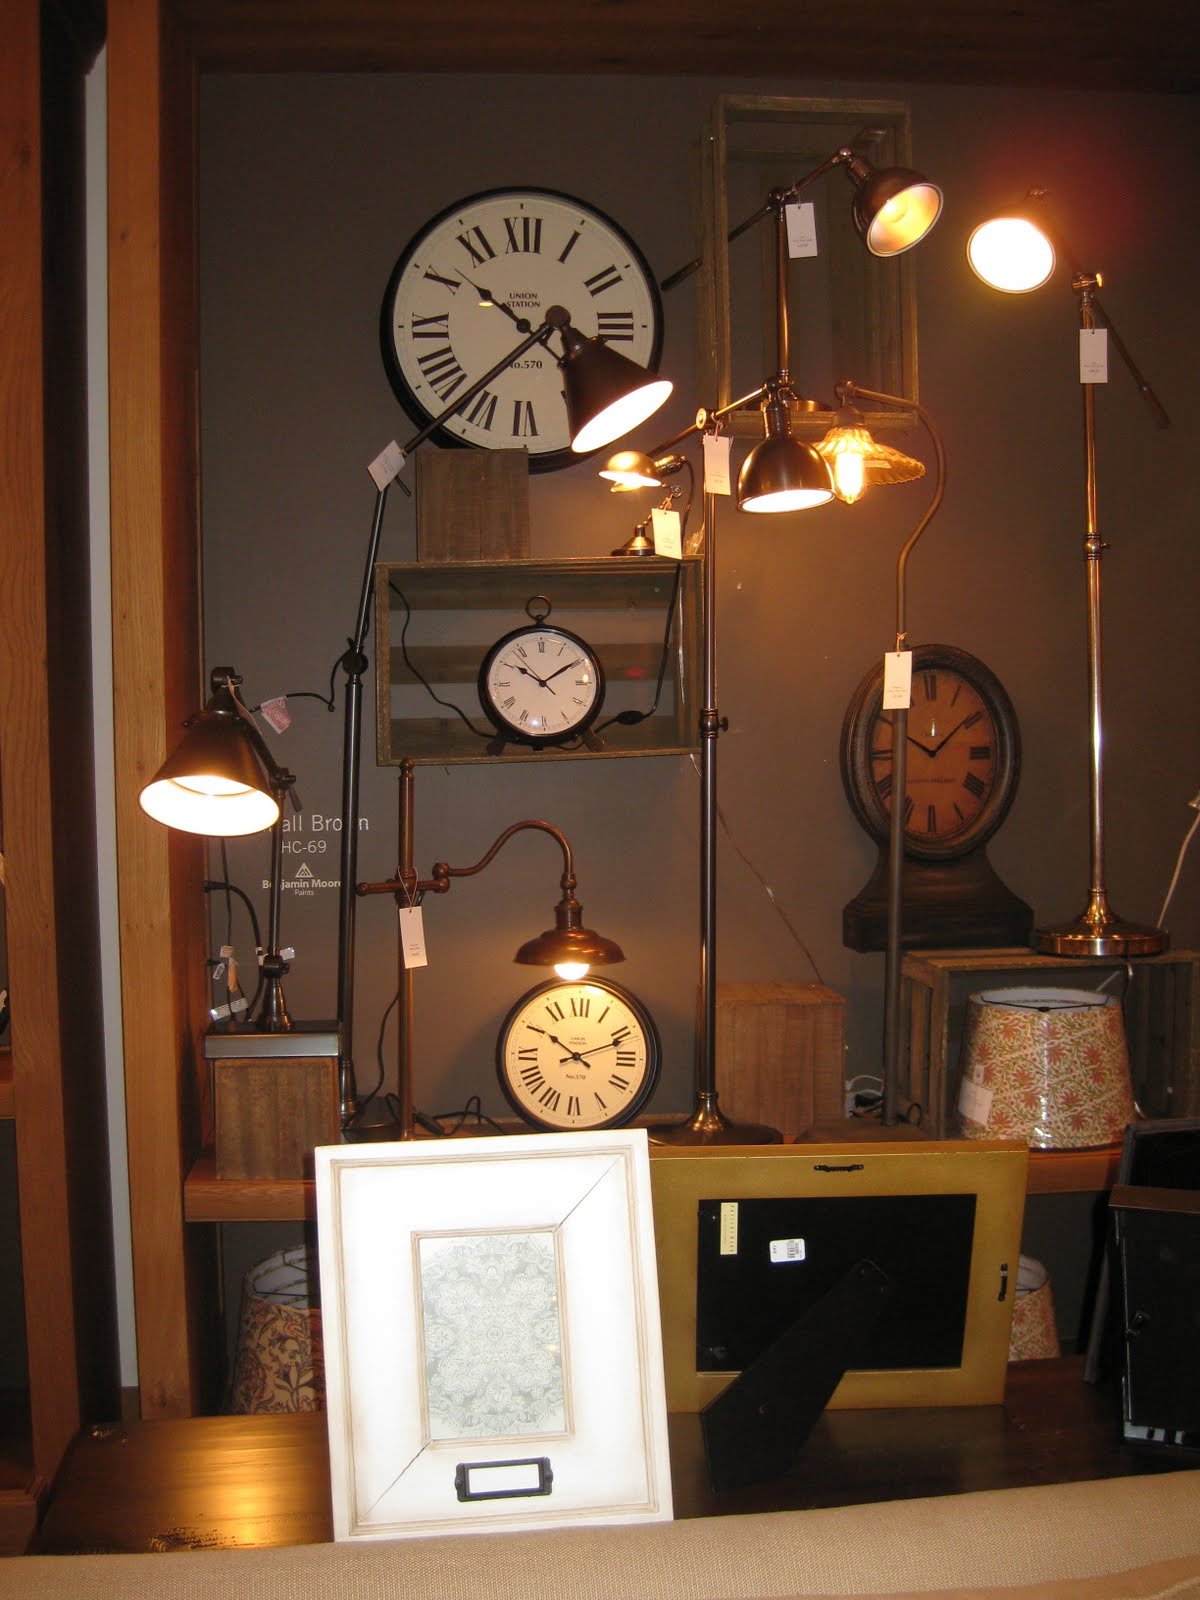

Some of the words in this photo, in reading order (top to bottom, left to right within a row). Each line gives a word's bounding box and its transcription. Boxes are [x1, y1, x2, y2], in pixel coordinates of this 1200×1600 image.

[510, 361, 543, 370] o.570
[312, 815, 369, 832] Bron
[281, 840, 327, 854] HC-69
[262, 879, 309, 891] Bjamin
